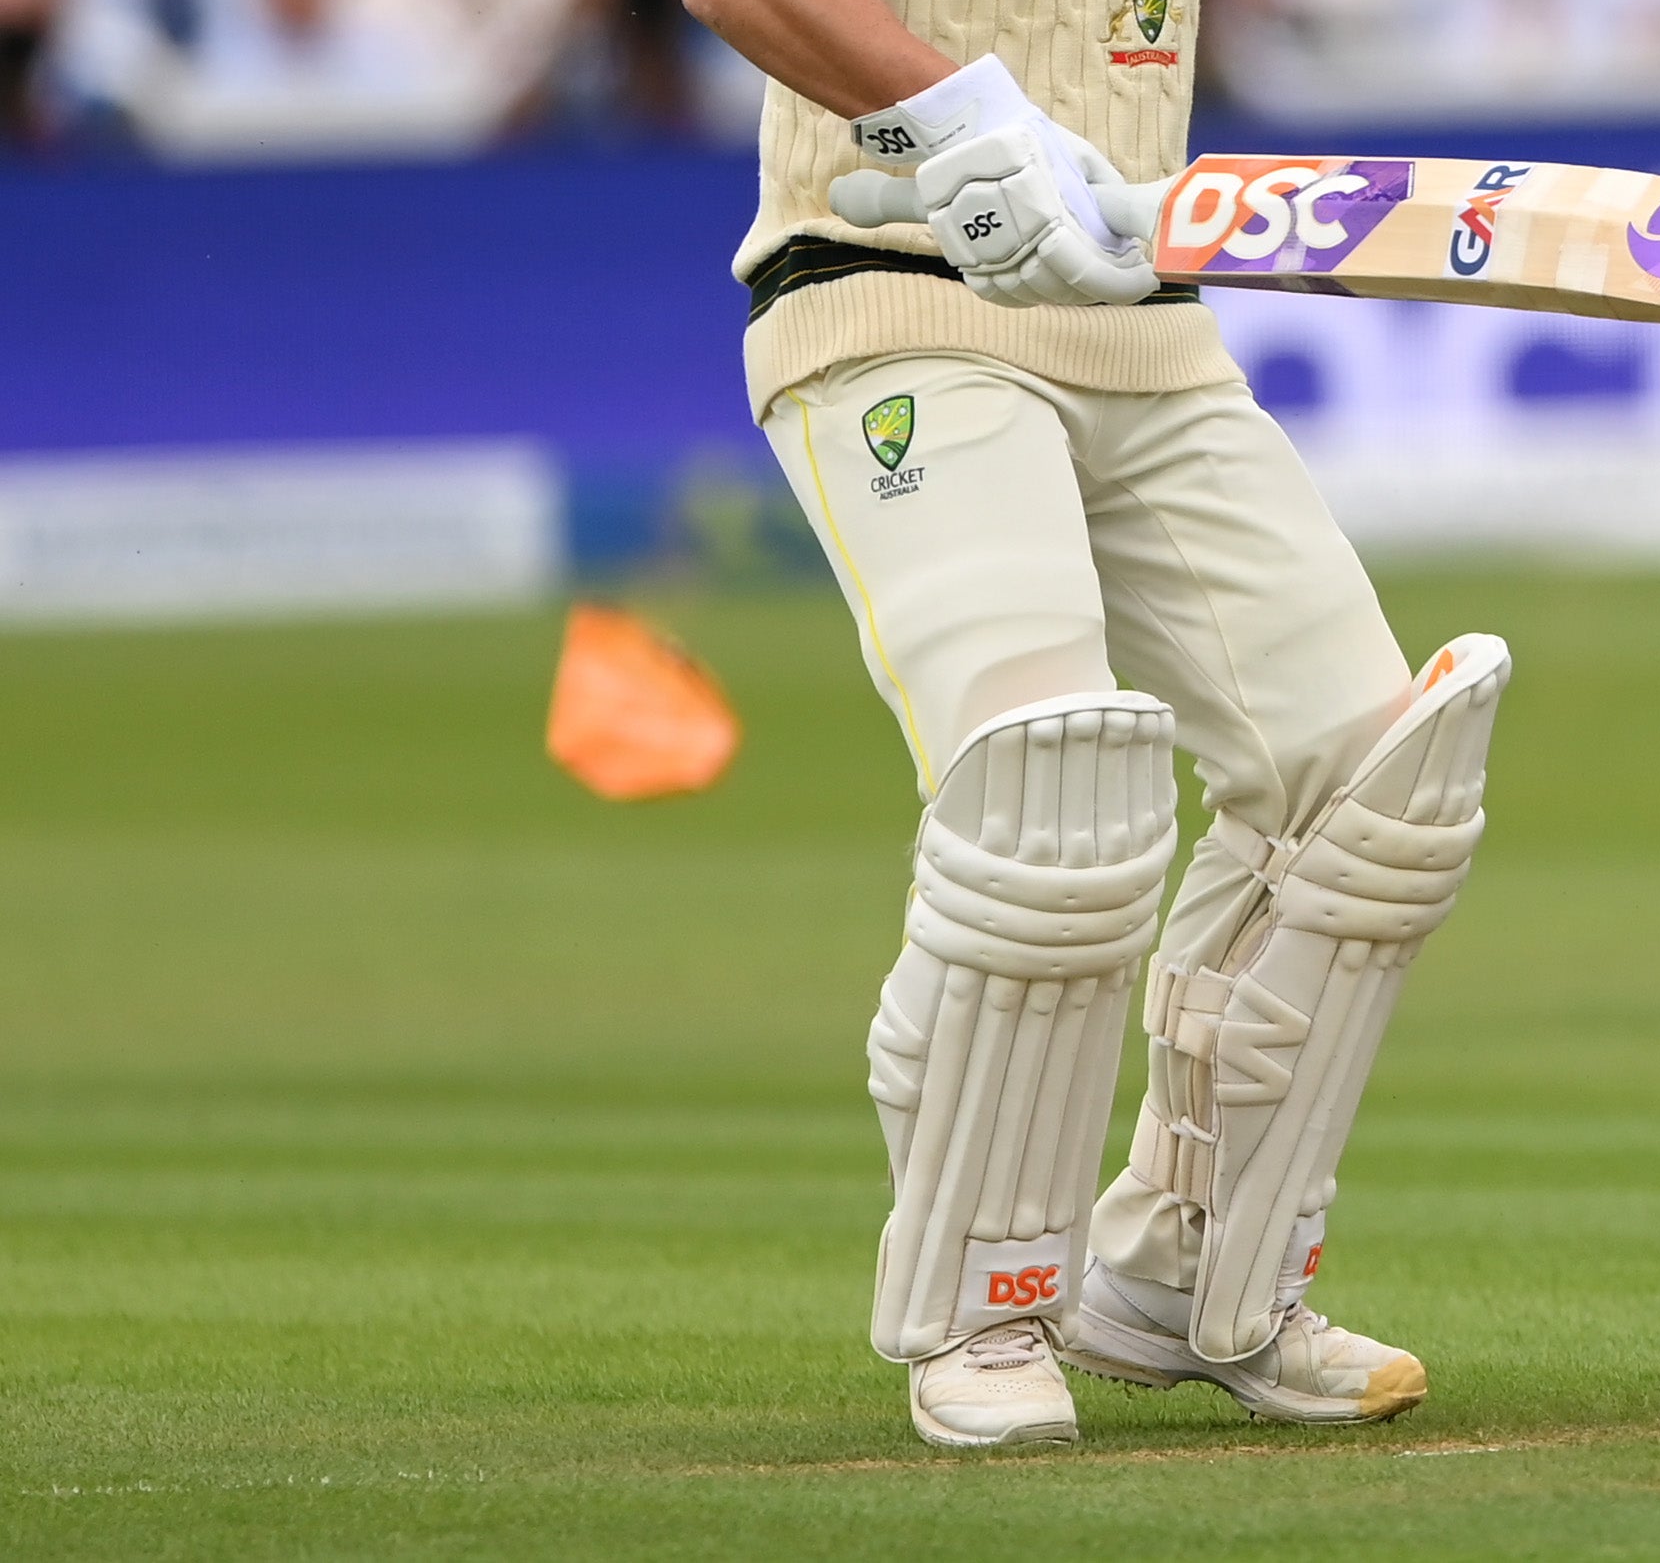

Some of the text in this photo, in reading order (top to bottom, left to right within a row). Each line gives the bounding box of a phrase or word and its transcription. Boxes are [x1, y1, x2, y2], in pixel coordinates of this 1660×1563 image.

[866, 125, 917, 154] DSC
[962, 210, 1003, 241] DSC
[1166, 166, 1370, 261] DSC
[870, 466, 926, 493] CRICKET
[880, 483, 920, 501] AUSTRALIA
[988, 1264, 1060, 1306] DSC
